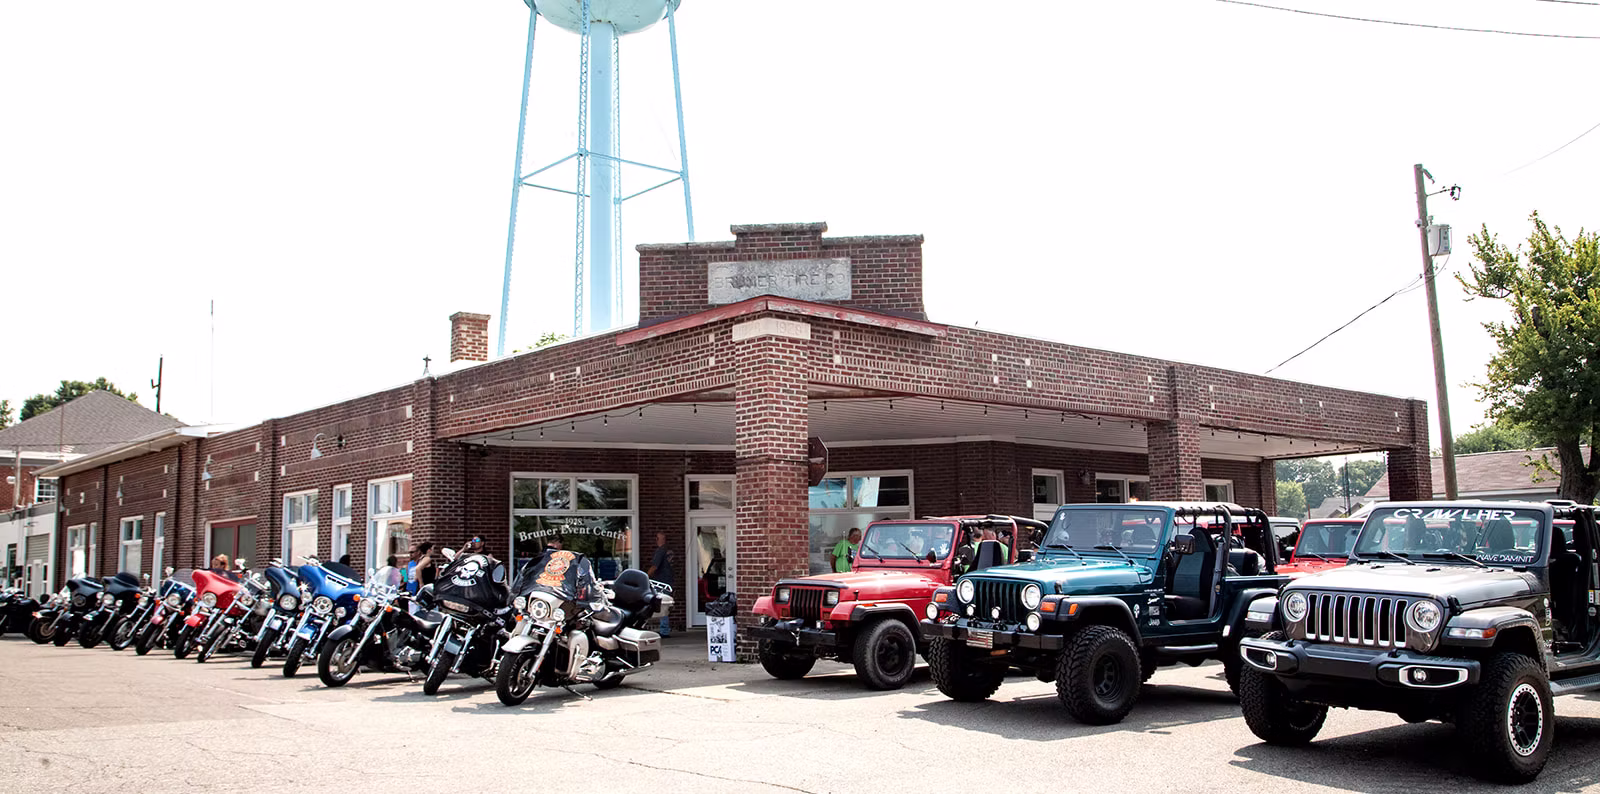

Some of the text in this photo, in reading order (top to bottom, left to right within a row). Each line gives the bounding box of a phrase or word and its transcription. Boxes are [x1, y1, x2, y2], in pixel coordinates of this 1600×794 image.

[783, 273, 820, 286] TIRE
[519, 525, 627, 542] Bruner Event Centre
[1475, 553, 1534, 563] WAVE DAMNIT
